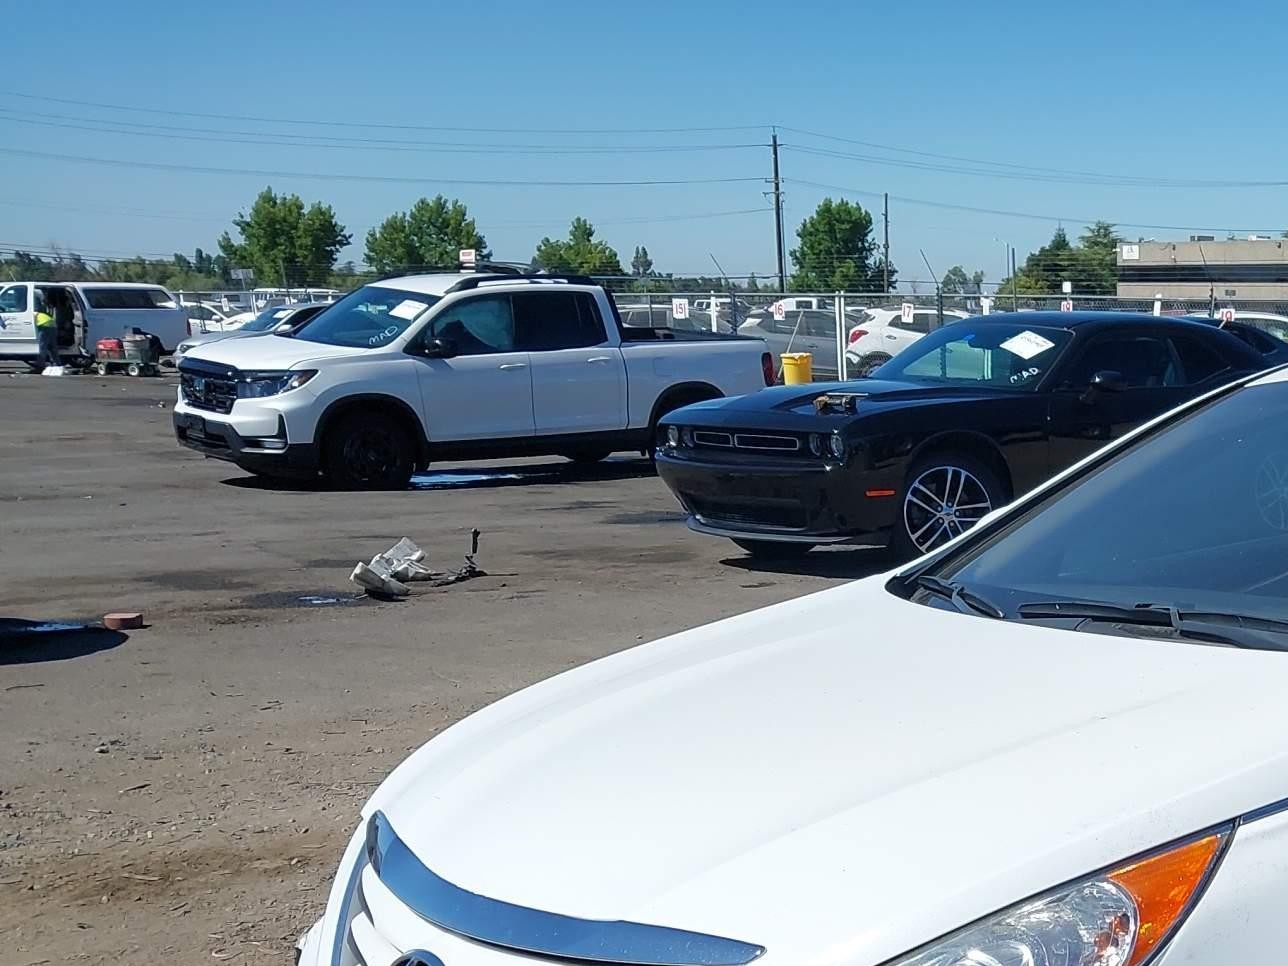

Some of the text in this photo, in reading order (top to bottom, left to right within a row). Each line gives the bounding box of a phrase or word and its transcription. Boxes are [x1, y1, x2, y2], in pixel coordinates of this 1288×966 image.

[675, 303, 687, 315] 151
[774, 304, 784, 316] 16
[903, 305, 912, 319] 17
